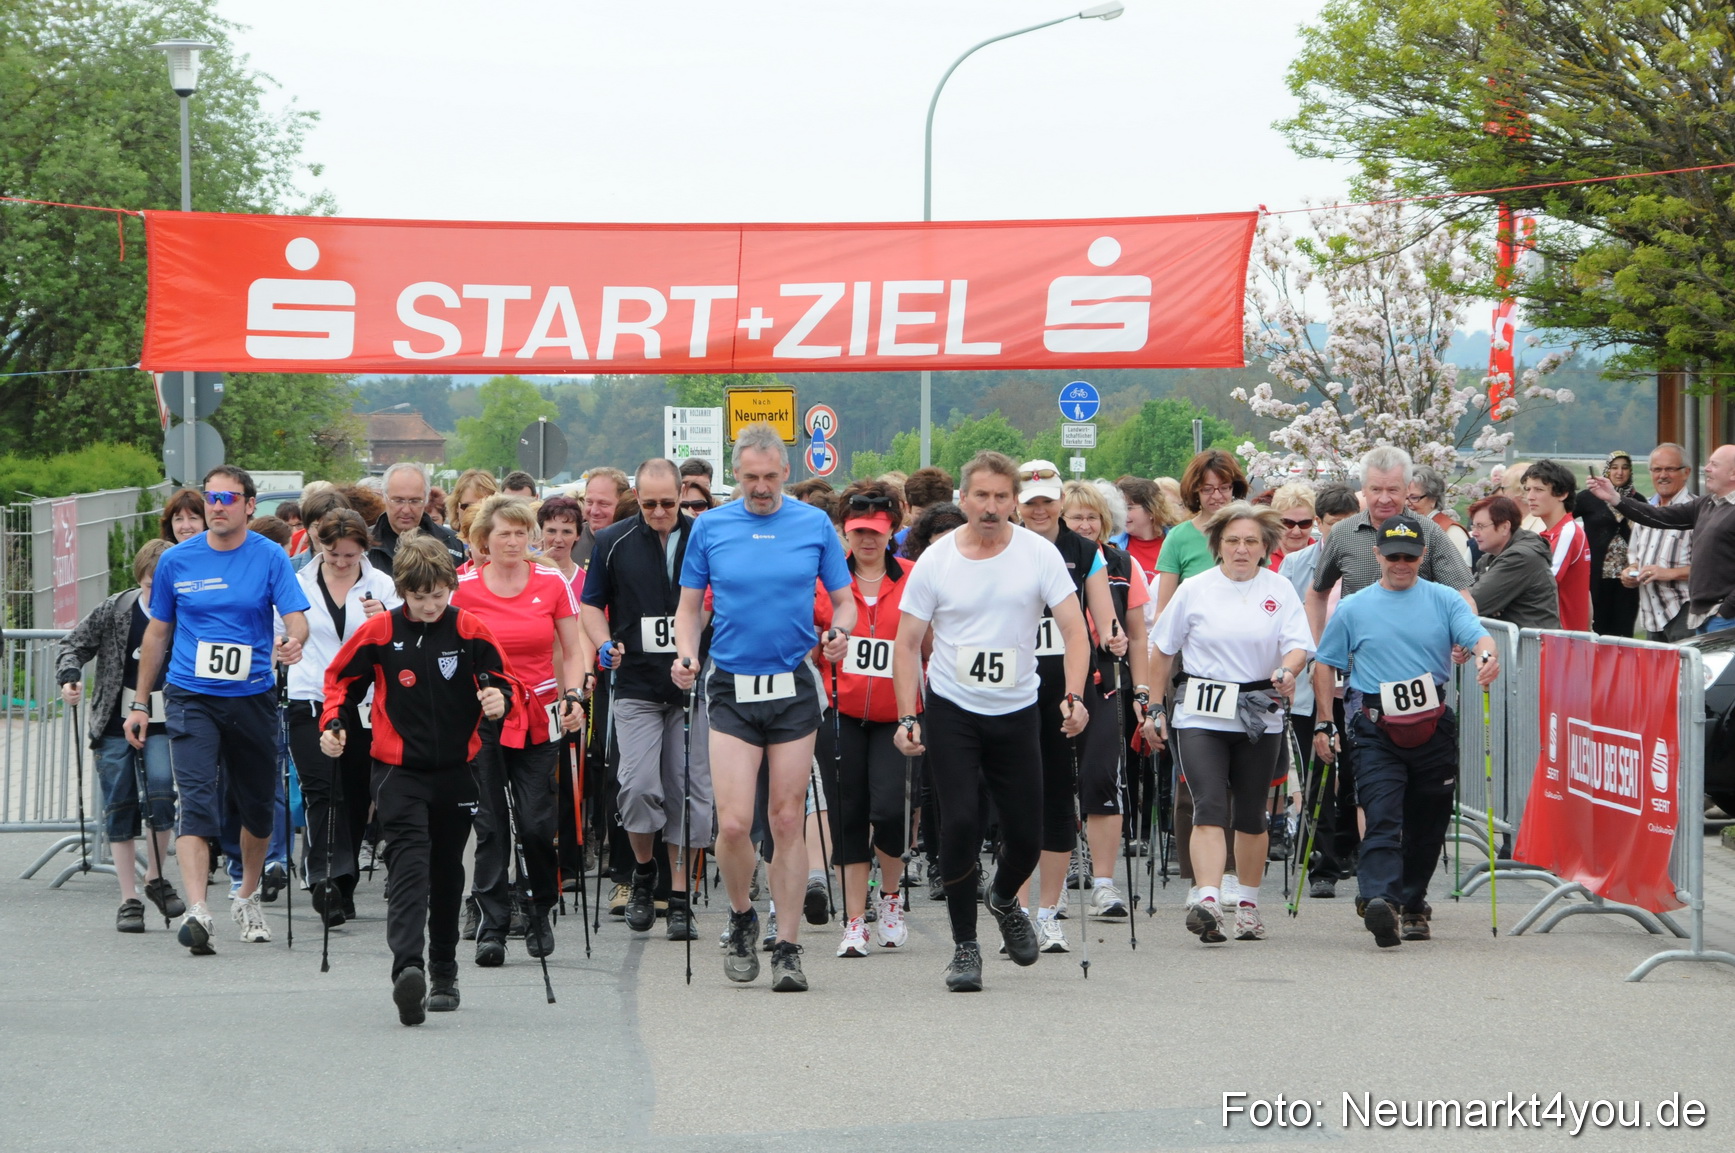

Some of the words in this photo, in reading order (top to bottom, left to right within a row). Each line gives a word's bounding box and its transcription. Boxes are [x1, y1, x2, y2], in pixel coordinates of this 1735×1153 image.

[735, 409, 789, 422] Neumarkt
[752, 398, 771, 406] Nach
[813, 415, 830, 431] 60
[208, 644, 242, 676] 50
[856, 639, 889, 671] 90
[969, 651, 1004, 683] 45
[1196, 682, 1227, 713] 117
[1392, 678, 1428, 712] 89
[1603, 743, 1617, 794] BEI
[1618, 745, 1639, 799] SEAT
[1651, 797, 1671, 814] SEAT
